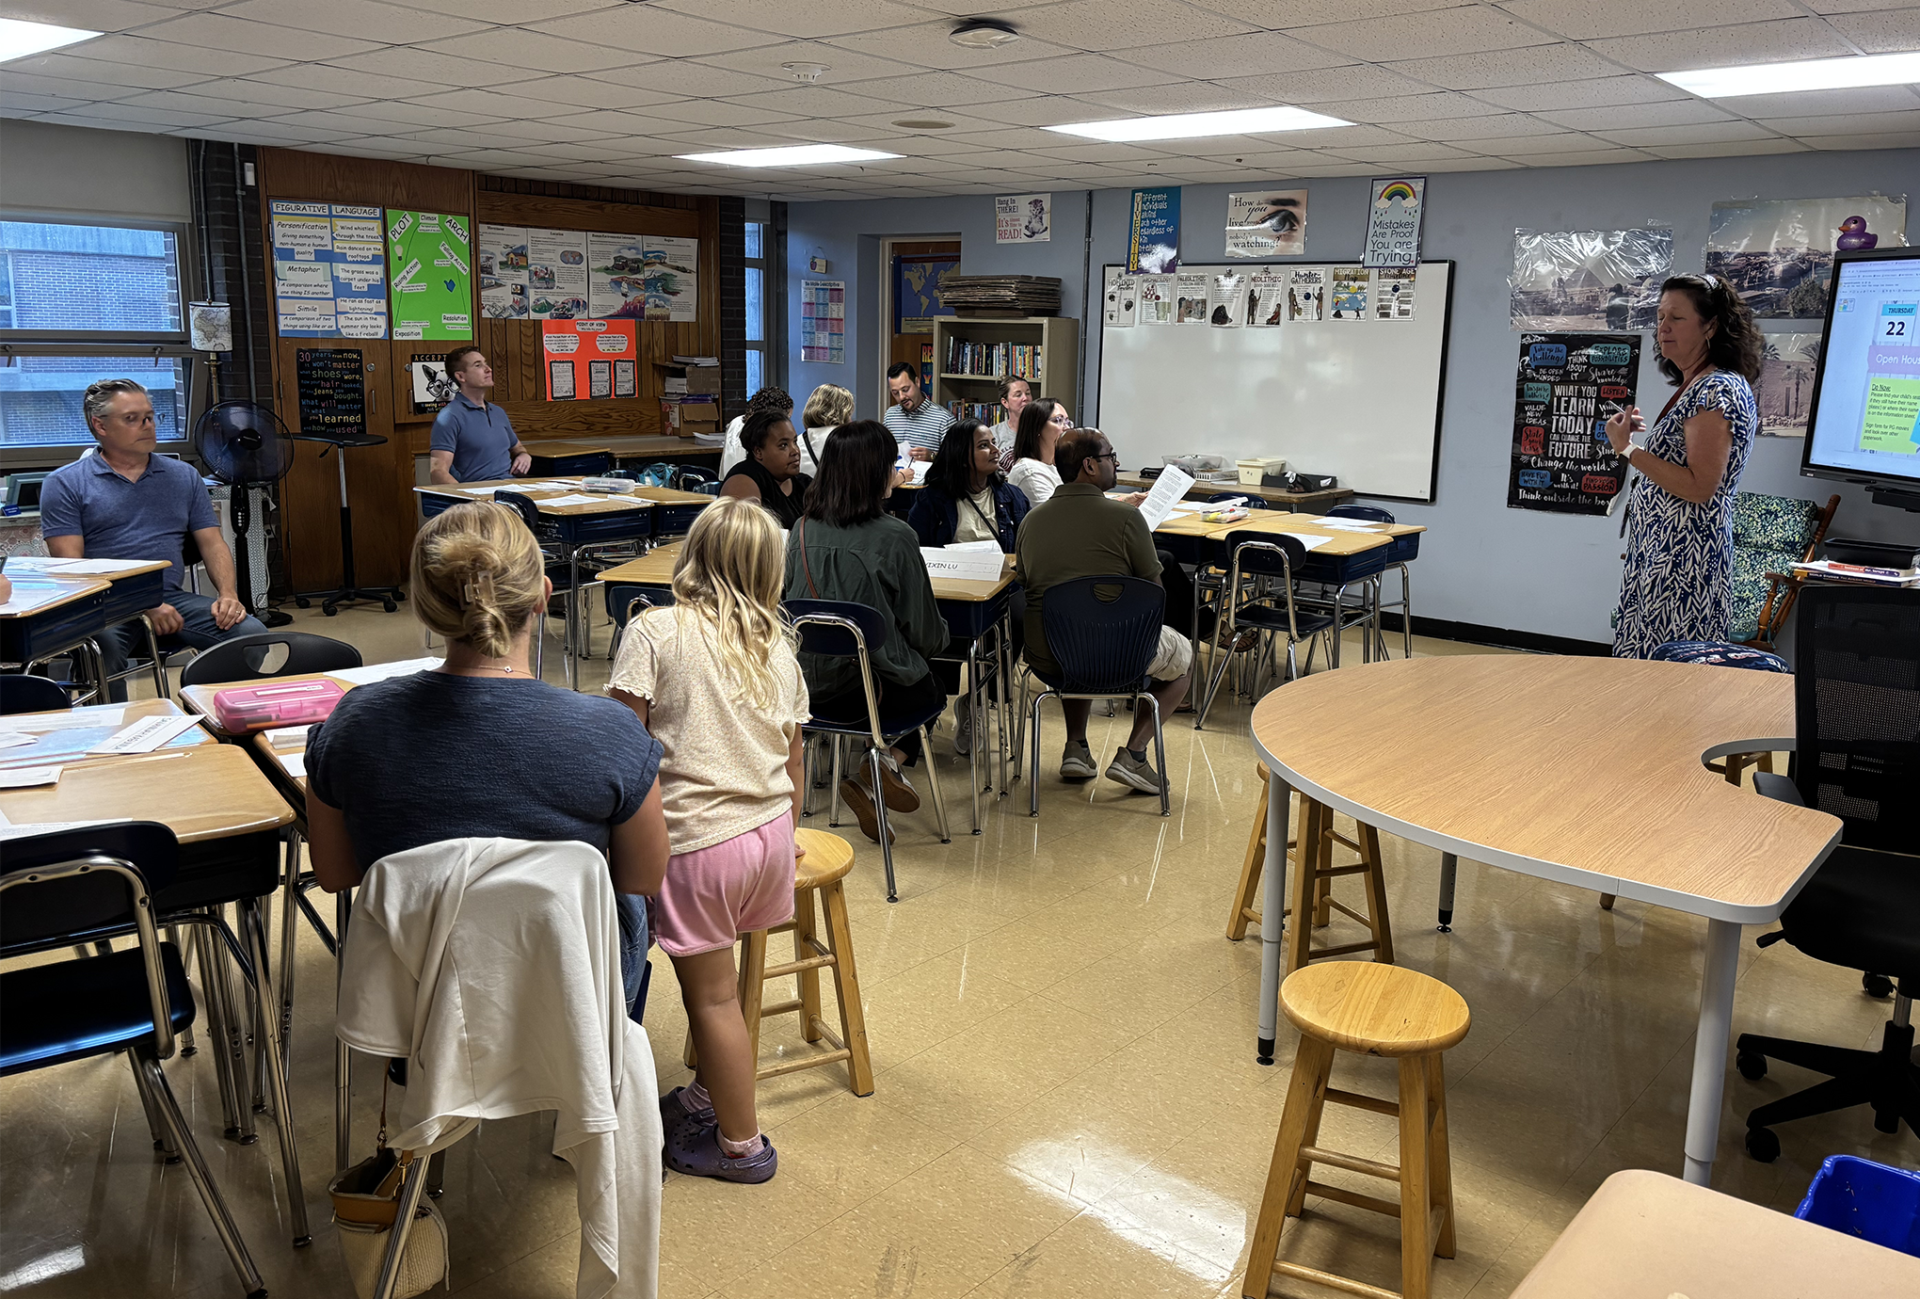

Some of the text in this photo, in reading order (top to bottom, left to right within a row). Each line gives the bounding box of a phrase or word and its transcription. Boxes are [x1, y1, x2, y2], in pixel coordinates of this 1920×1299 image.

[1234, 197, 1254, 207] How
[276, 204, 378, 216] FIGURATIVE LANGUAGE
[997, 206, 1019, 214] THERE!
[1245, 206, 1268, 223] you
[277, 222, 328, 230] Personification
[391, 214, 410, 239] PLOT
[998, 218, 1009, 228] It's
[1229, 218, 1243, 227] live
[1373, 220, 1415, 229] Mistakes
[446, 219, 468, 241] ARCH
[998, 229, 1022, 240] READ!
[1372, 229, 1414, 238] Are Proof
[1233, 236, 1280, 249] watching?
[1371, 240, 1412, 249] You are
[440, 243, 454, 259] Falling
[454, 258, 468, 273] Action
[1370, 250, 1414, 265] Trying.
[394, 272, 408, 289] Rising
[406, 261, 419, 277] Action
[1886, 321, 1905, 336] 22
[299, 352, 311, 362] 30
[1568, 355, 1588, 363] THINK
[1876, 354, 1898, 365] Open
[312, 369, 341, 378] shoes
[1566, 365, 1587, 373] ABOUT
[1588, 367, 1616, 381] Share
[1555, 385, 1597, 397] WHAT YOU
[1603, 388, 1625, 396] LISTEN
[1553, 397, 1595, 416] LEARN
[319, 414, 361, 423] learned
[1551, 416, 1594, 435] TODAY
[1548, 442, 1591, 459] FUTURE
[1531, 456, 1611, 472] Change the world.
[1561, 473, 1573, 482] It's
[1584, 483, 1614, 492] PASSION
[1519, 488, 1542, 500] Think
[1543, 492, 1575, 503] outside
[1578, 494, 1592, 504] the
